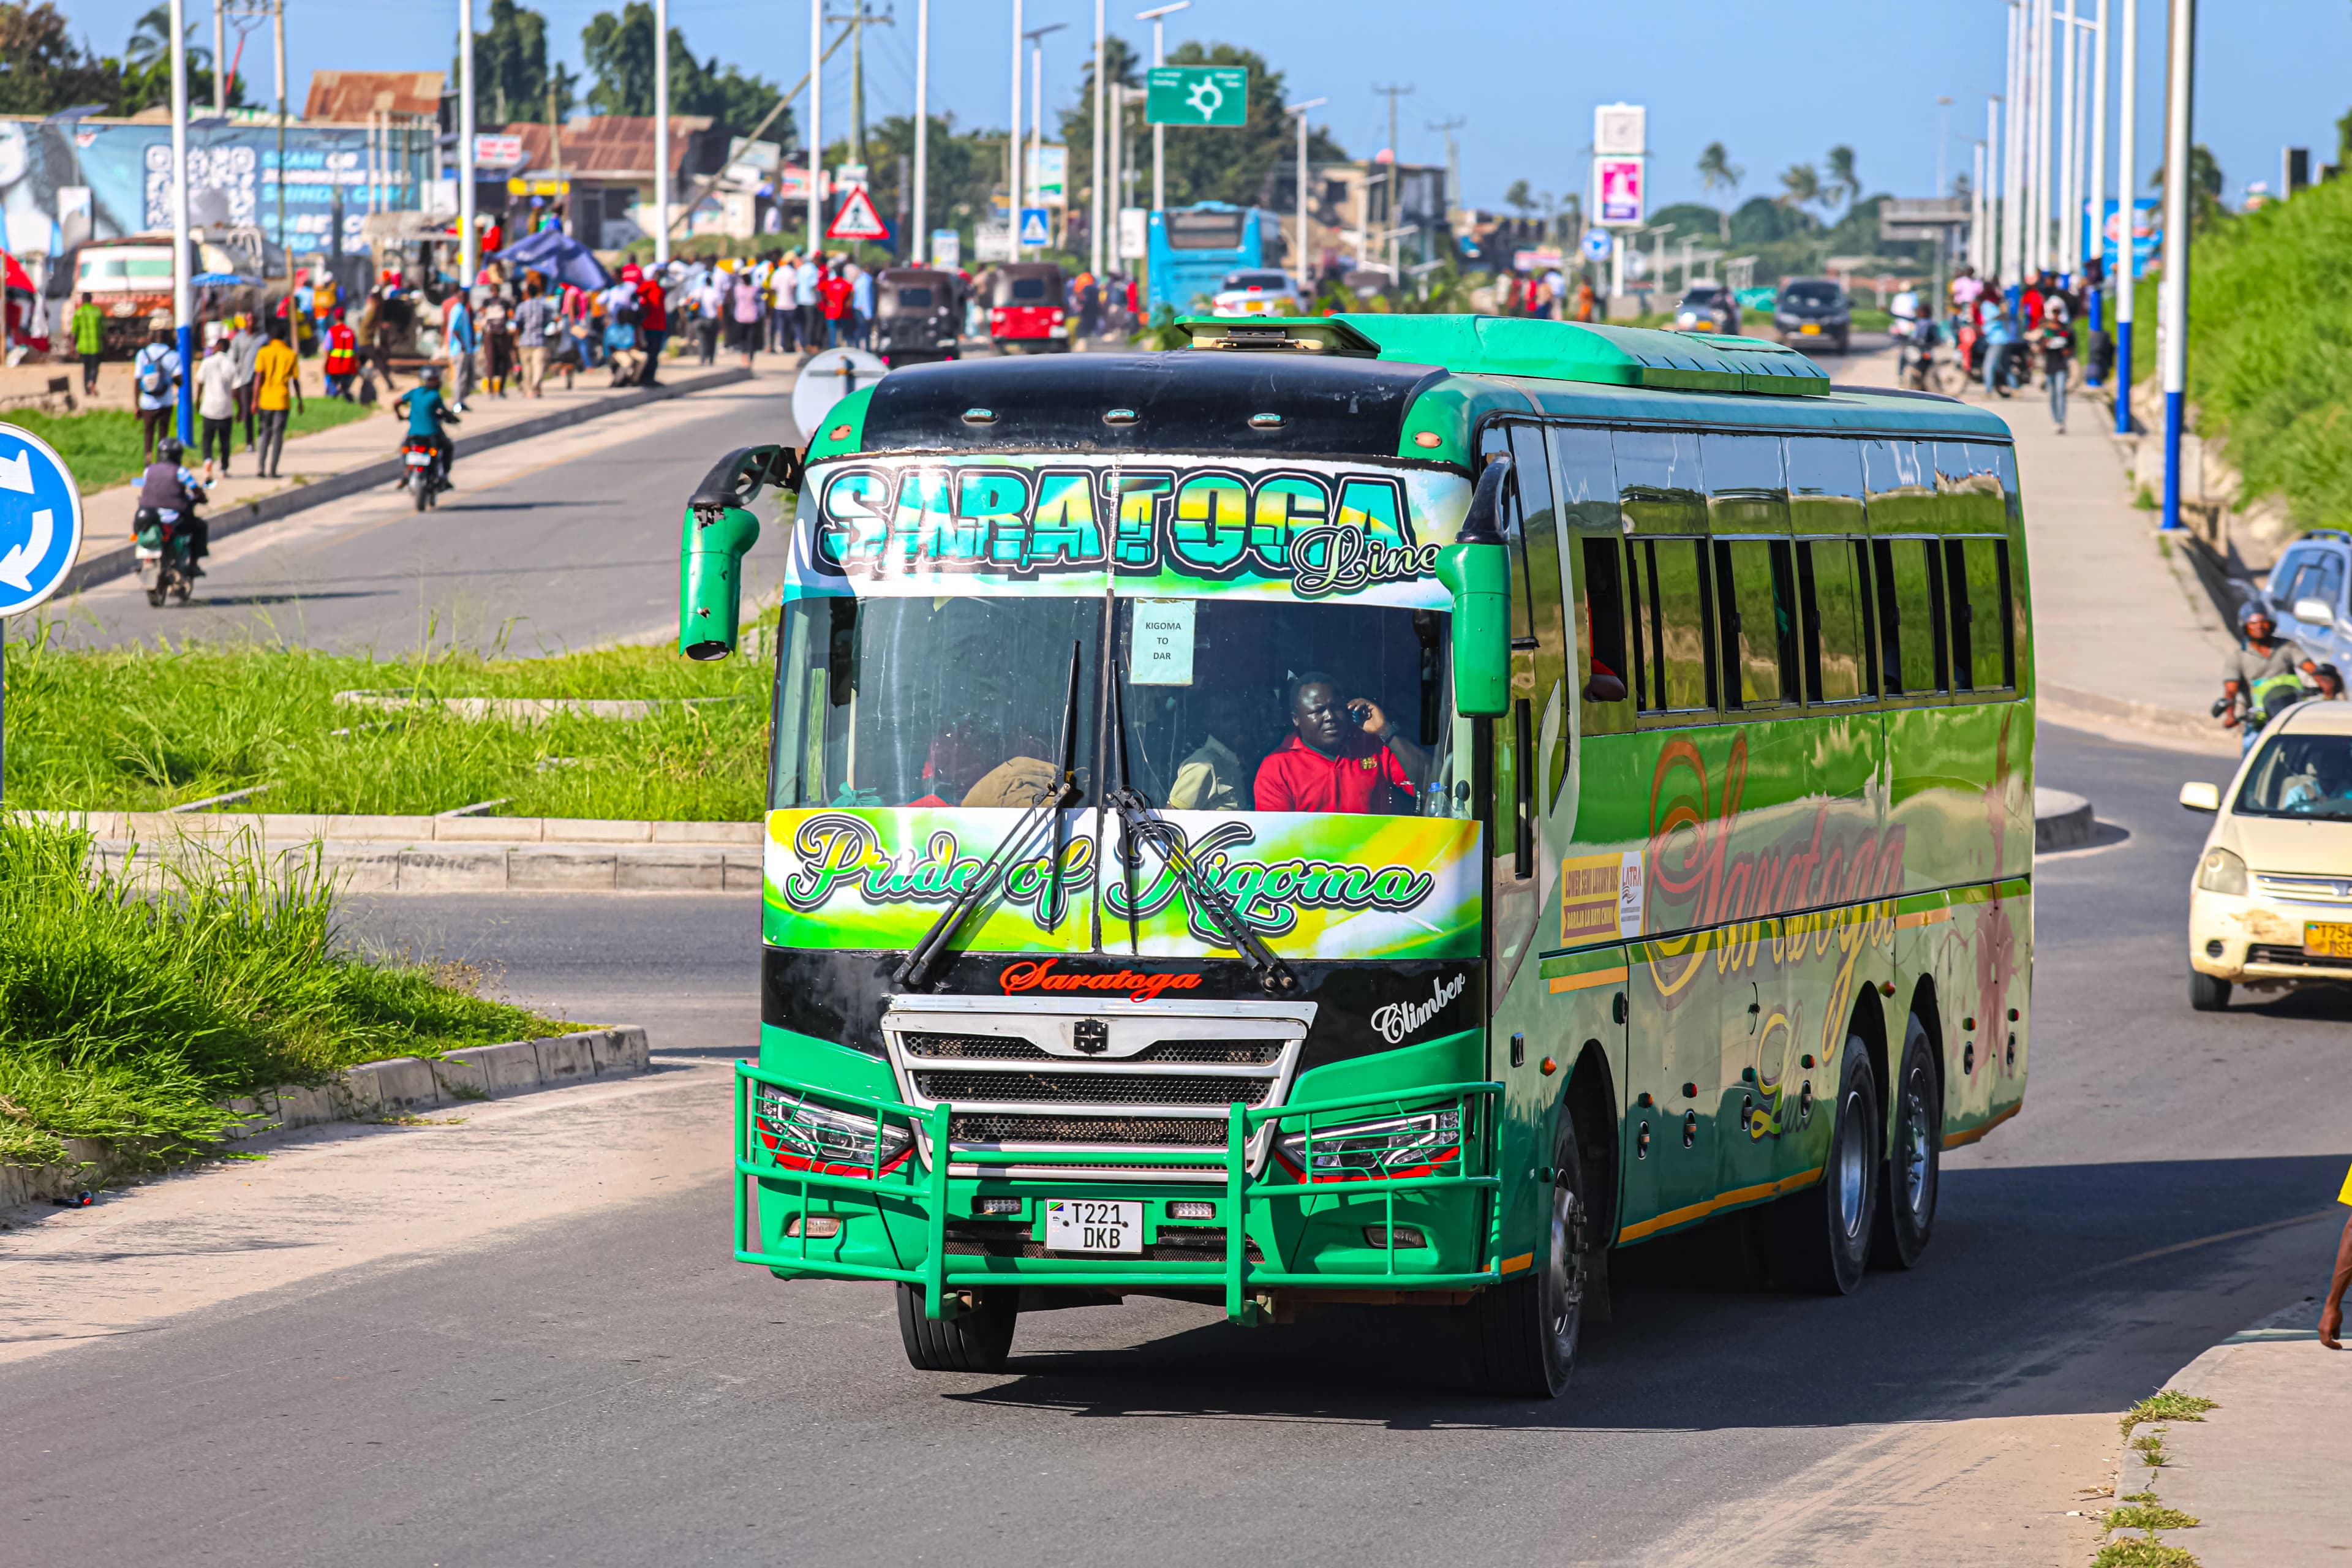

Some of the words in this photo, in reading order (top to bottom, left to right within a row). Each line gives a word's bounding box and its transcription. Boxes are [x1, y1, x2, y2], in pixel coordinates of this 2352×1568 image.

[1289, 524, 1440, 599] Line
[1145, 622, 1182, 630] KIGOMA
[1153, 652, 1171, 660] DAR
[784, 813, 1000, 911] Pride
[1003, 834, 1096, 926] of
[1103, 820, 1434, 949] Kigoma
[1623, 865, 1642, 888] LATRA
[1000, 957, 1202, 1003] Saratoga
[1371, 972, 1466, 1044] Climber
[1071, 1203, 1121, 1224] T221
[1083, 1227, 1120, 1249] DKB
